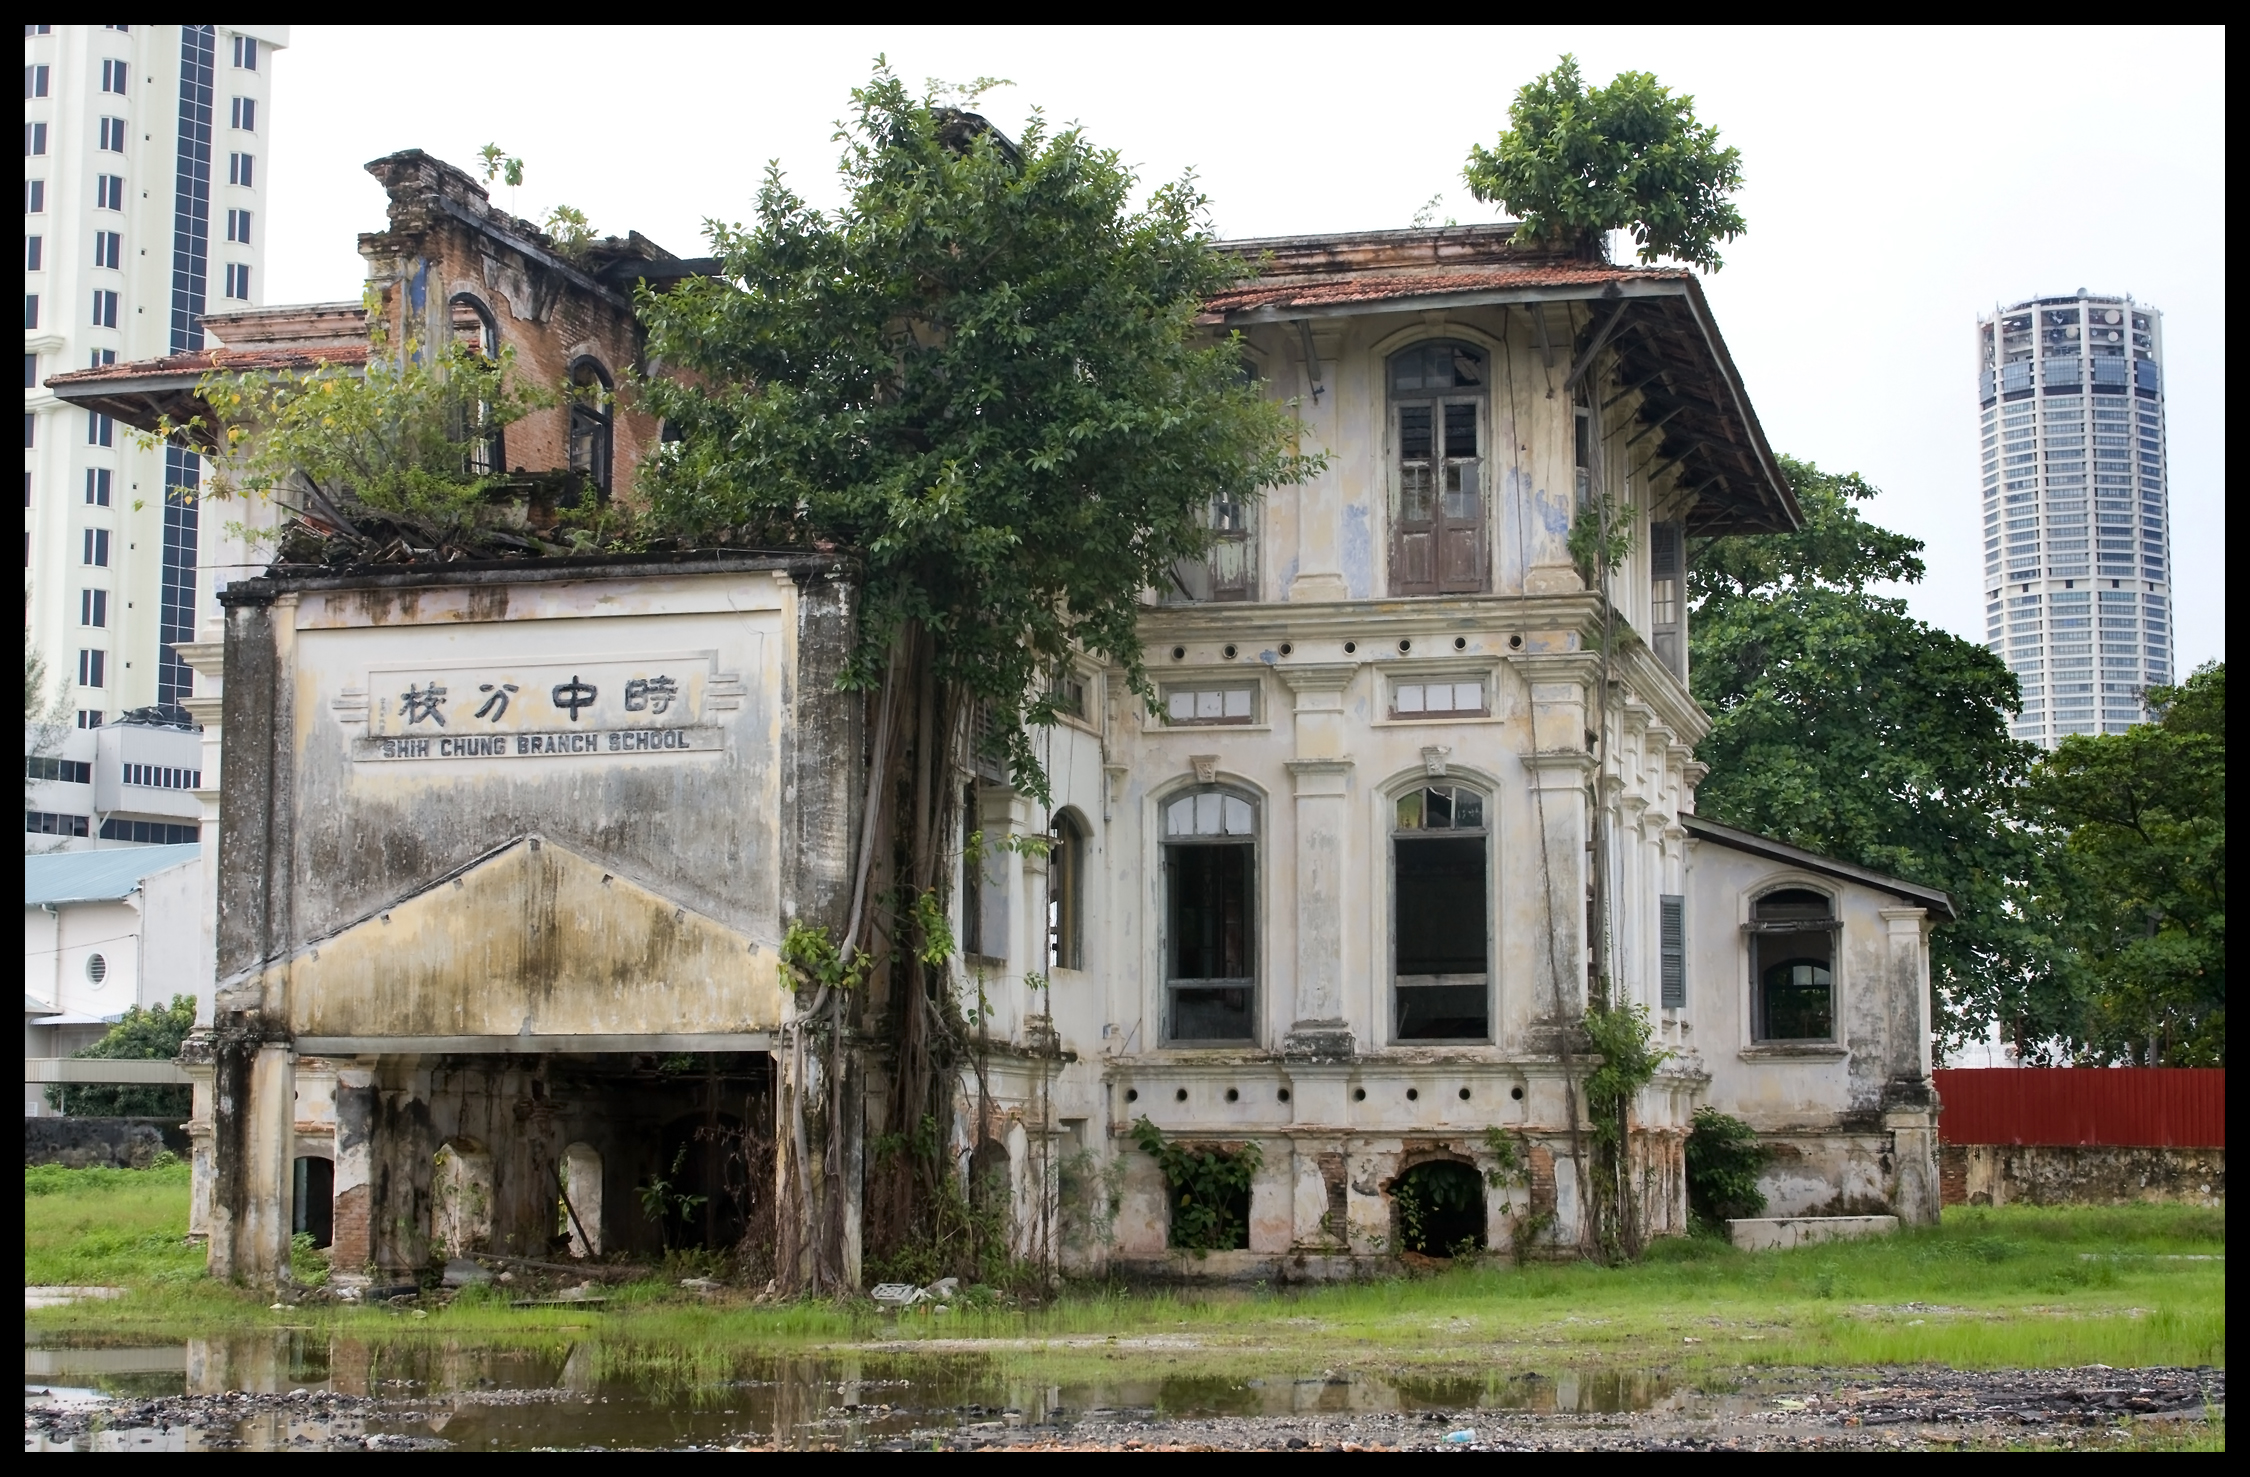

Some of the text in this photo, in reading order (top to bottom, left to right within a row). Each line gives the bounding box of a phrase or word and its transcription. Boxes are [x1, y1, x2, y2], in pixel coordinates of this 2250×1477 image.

[383, 730, 691, 758] SHIH CHUNG BRANCH SCHOOL
